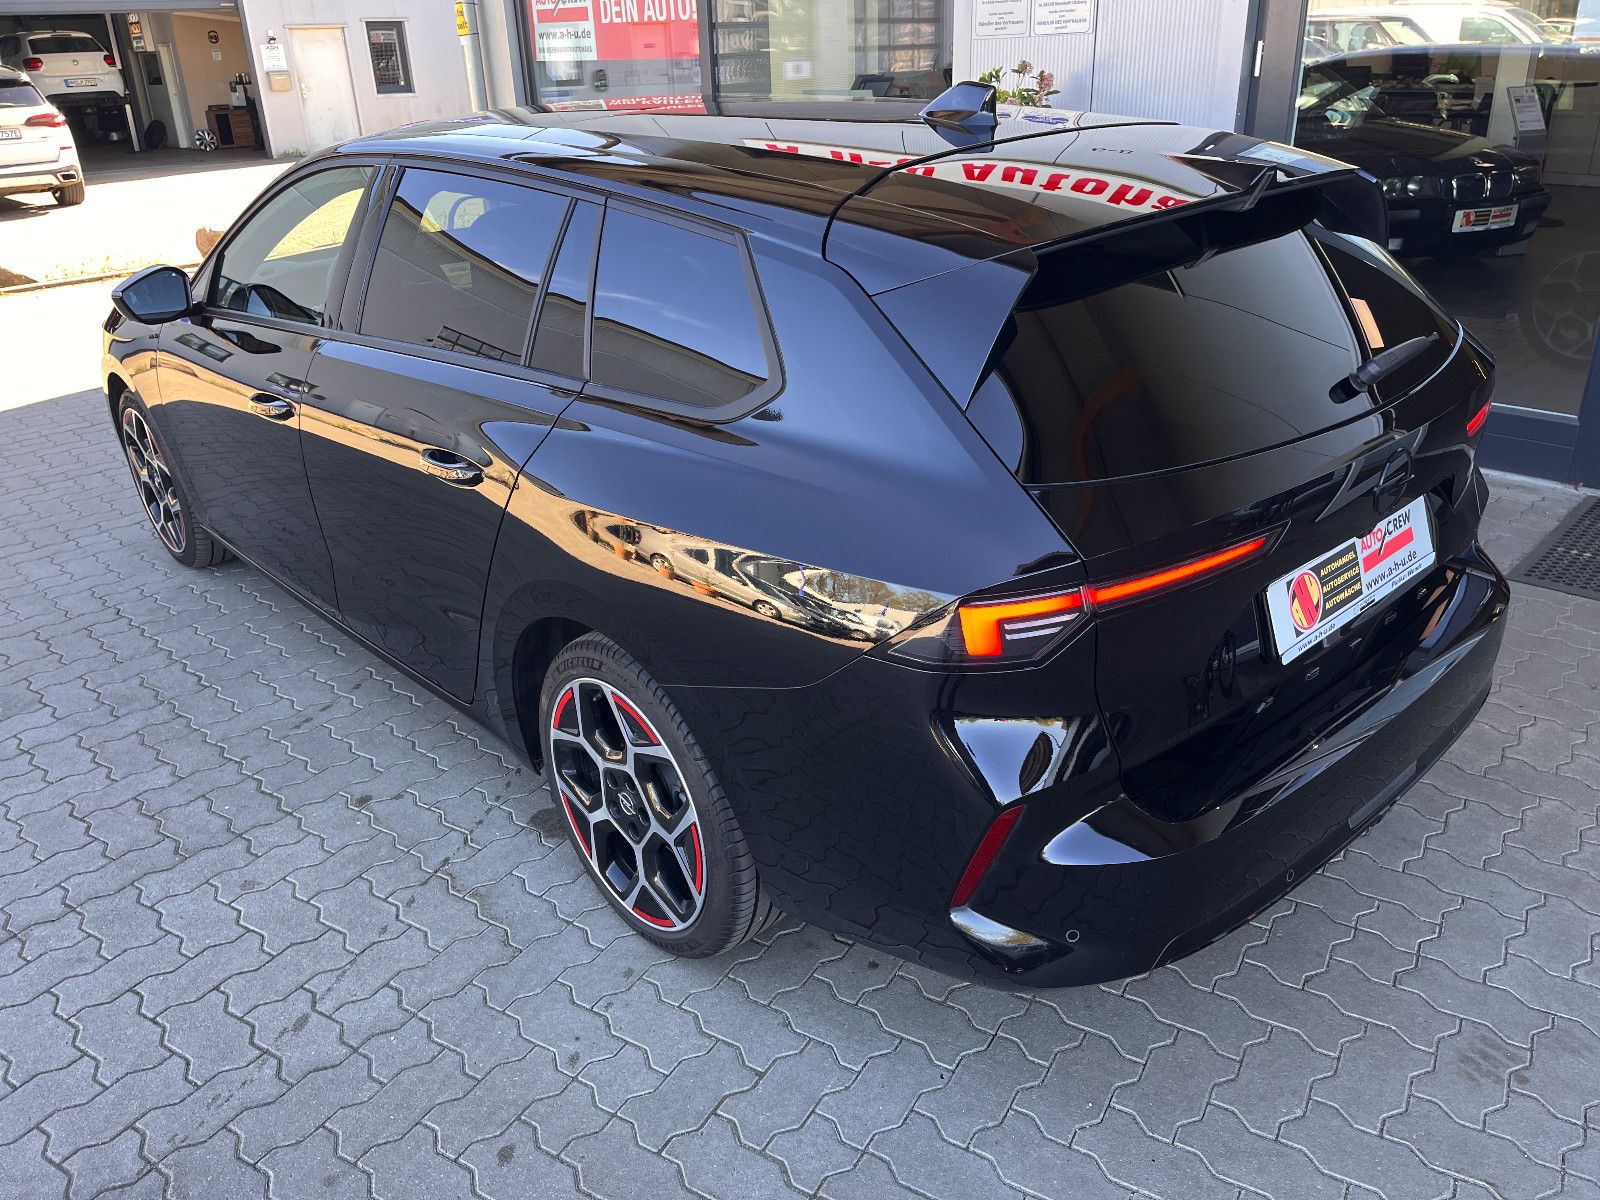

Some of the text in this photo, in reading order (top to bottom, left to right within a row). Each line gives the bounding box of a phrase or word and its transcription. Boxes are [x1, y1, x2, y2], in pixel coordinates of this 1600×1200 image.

[600, 0, 639, 23] DEIN
[538, 28, 591, 40] www.a-h-u.de
[1320, 551, 1356, 577] AUTOHANDEL
[1366, 550, 1417, 591] www.a-h-u.de
[1323, 565, 1360, 593] AUTOSERVICE
